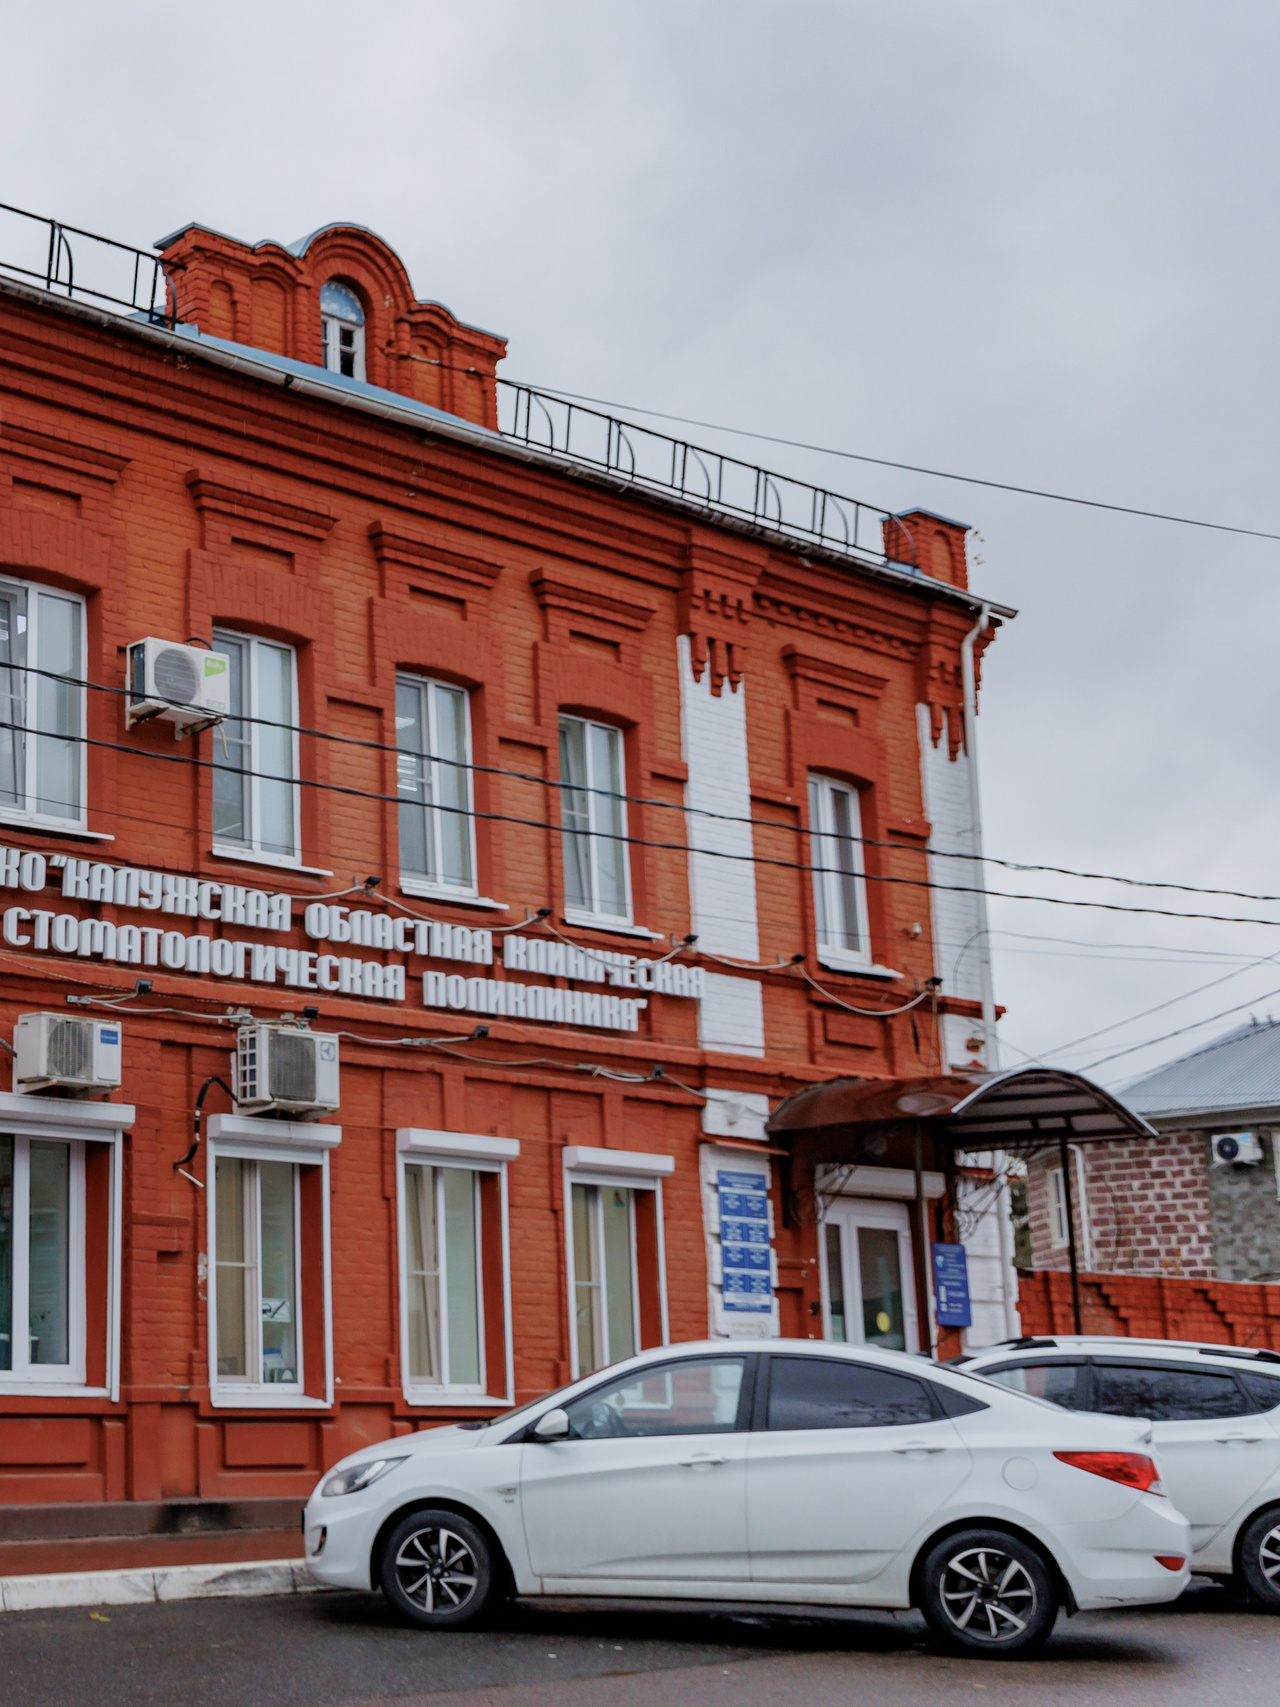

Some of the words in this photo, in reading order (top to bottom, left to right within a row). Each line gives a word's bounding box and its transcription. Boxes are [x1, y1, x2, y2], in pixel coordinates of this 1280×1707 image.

[3, 906, 406, 1001] СТОМАТОЛОГИЧЕСКАЯ
[422, 970, 648, 1033] ПОЛИКЛИНИКА"
[304, 902, 494, 966] ОБЛАСТНАЯ
[503, 933, 708, 999] КЛИНИЧЕСКАЯ
